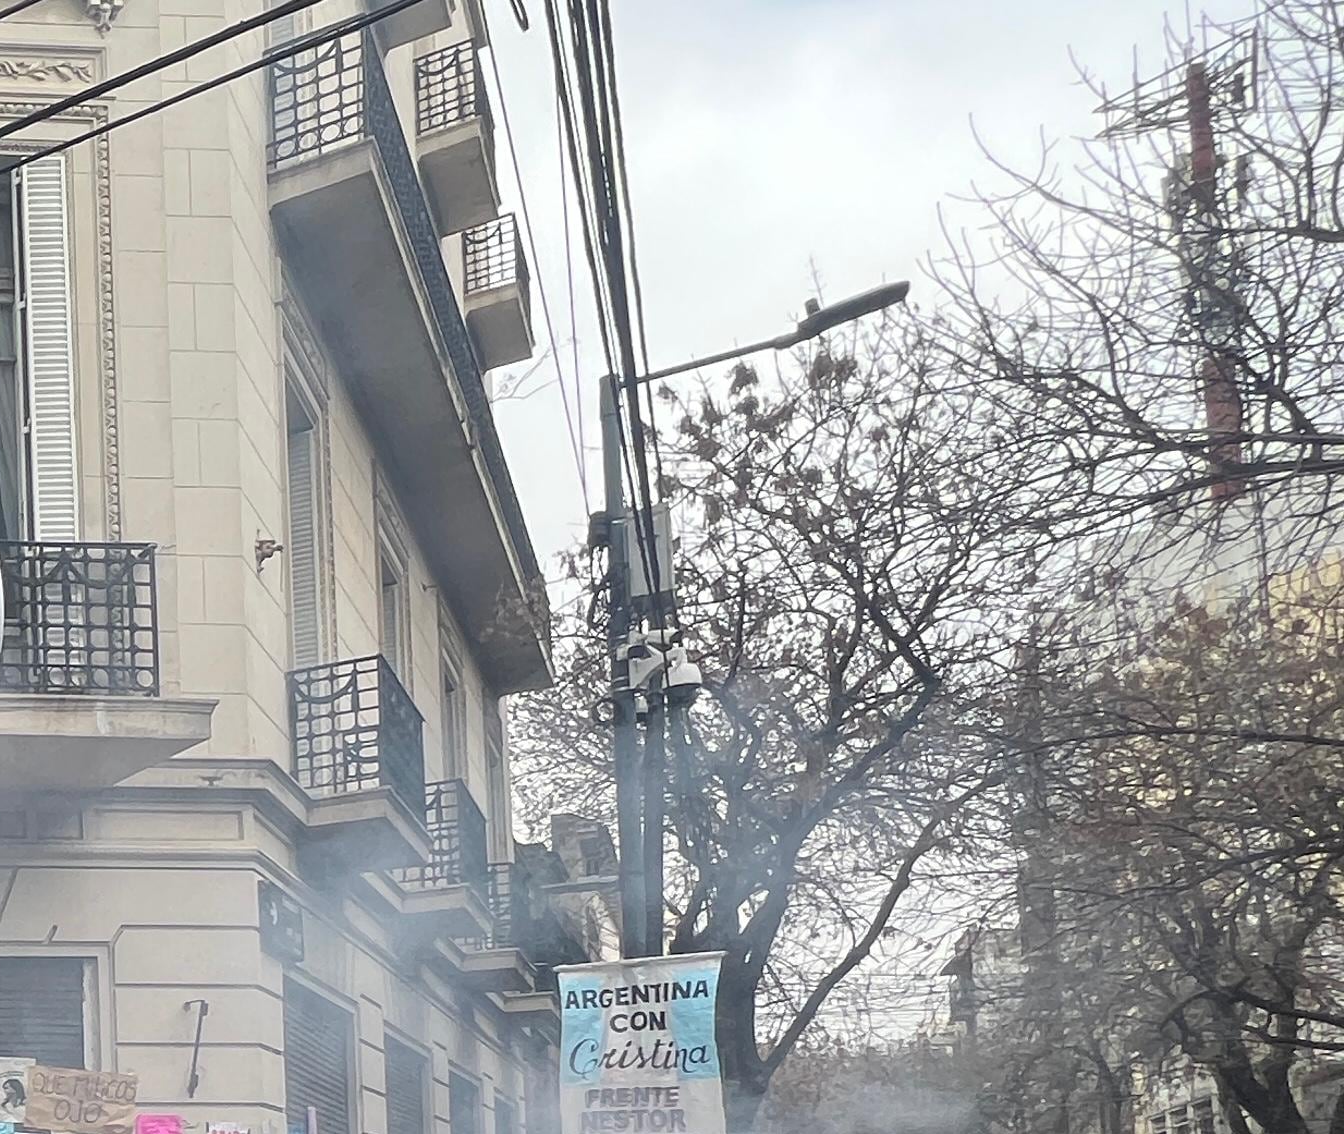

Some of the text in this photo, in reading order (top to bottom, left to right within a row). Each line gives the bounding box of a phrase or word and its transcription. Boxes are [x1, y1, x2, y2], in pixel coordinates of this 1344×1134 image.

[564, 980, 710, 1010] ARGENTINA
[609, 1011, 667, 1033] CON
[569, 1038, 712, 1080] Cristina
[584, 1086, 680, 1109] FRENTE
[579, 1109, 687, 1133] NESTOR
